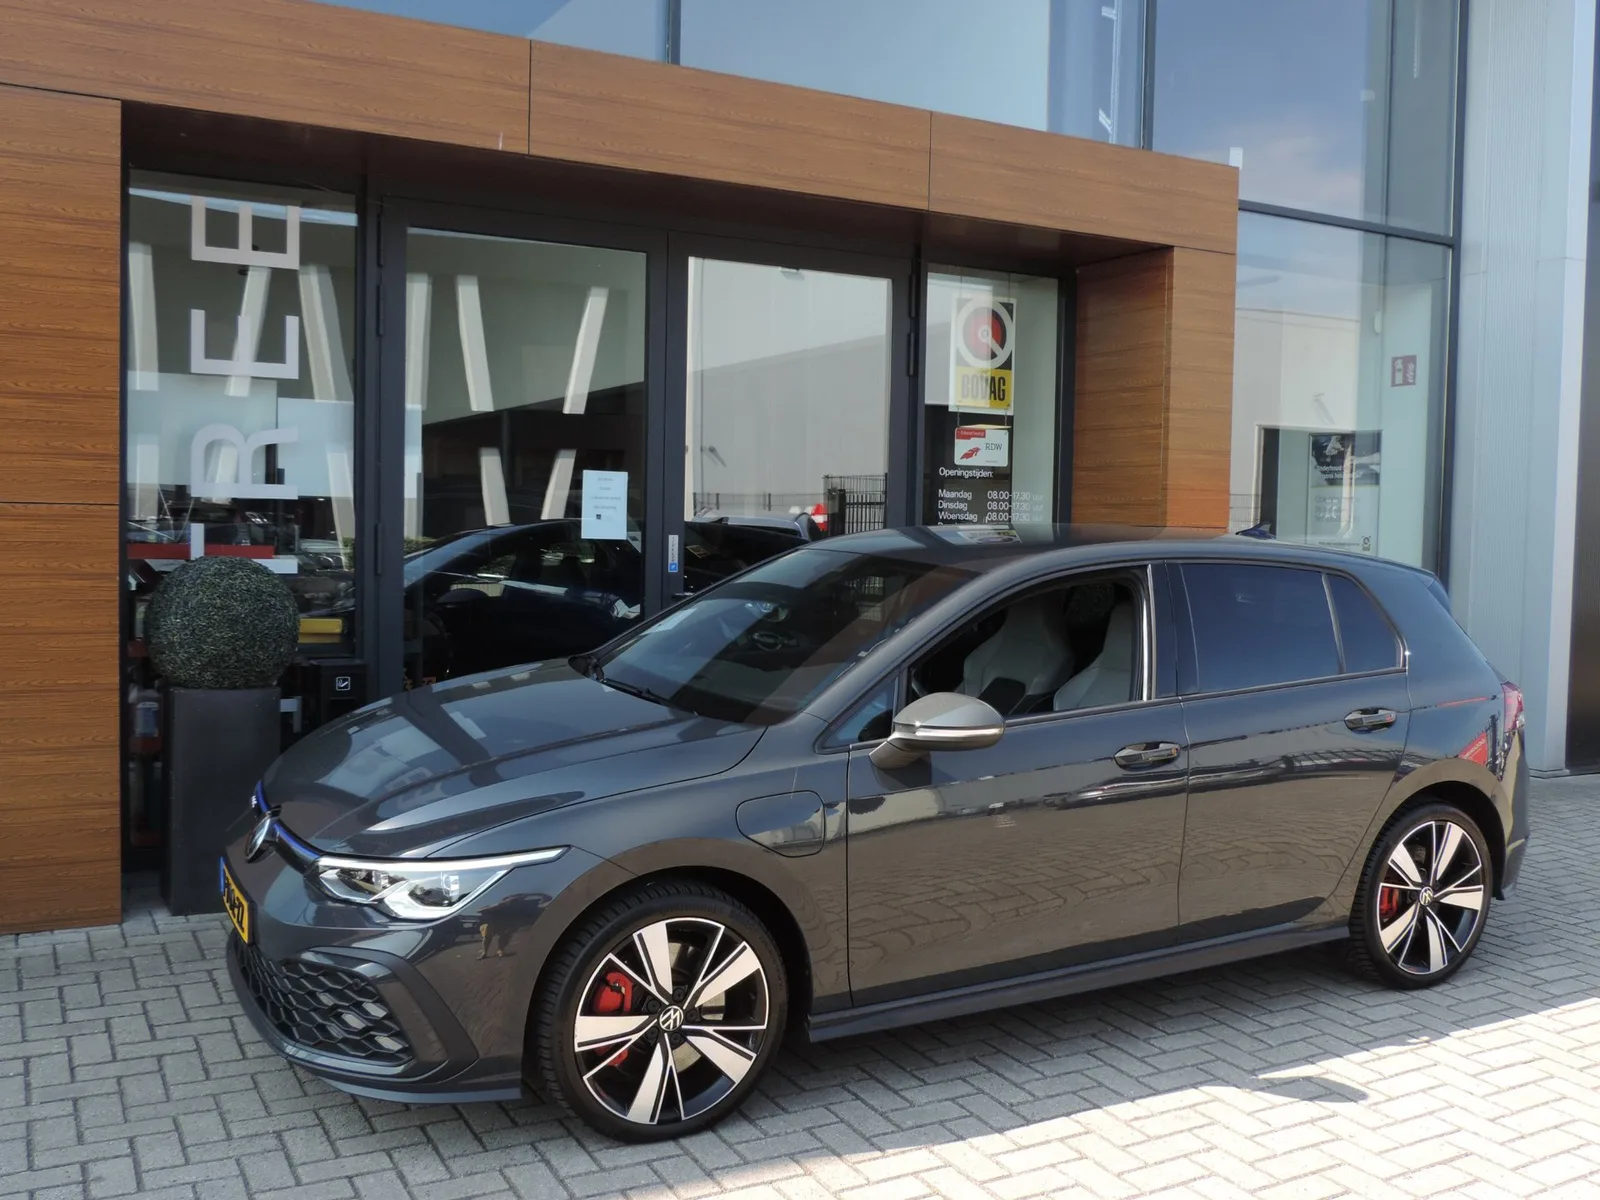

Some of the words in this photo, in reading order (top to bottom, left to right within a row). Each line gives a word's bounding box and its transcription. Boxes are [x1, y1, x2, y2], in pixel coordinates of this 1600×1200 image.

[962, 374, 1005, 401] BOVAG
[985, 443, 1002, 451] RDW
[938, 467, 994, 479] Openingstijden:
[938, 489, 973, 500] Maandag
[938, 500, 968, 511] Dinsdag
[938, 511, 978, 522] Woensdag
